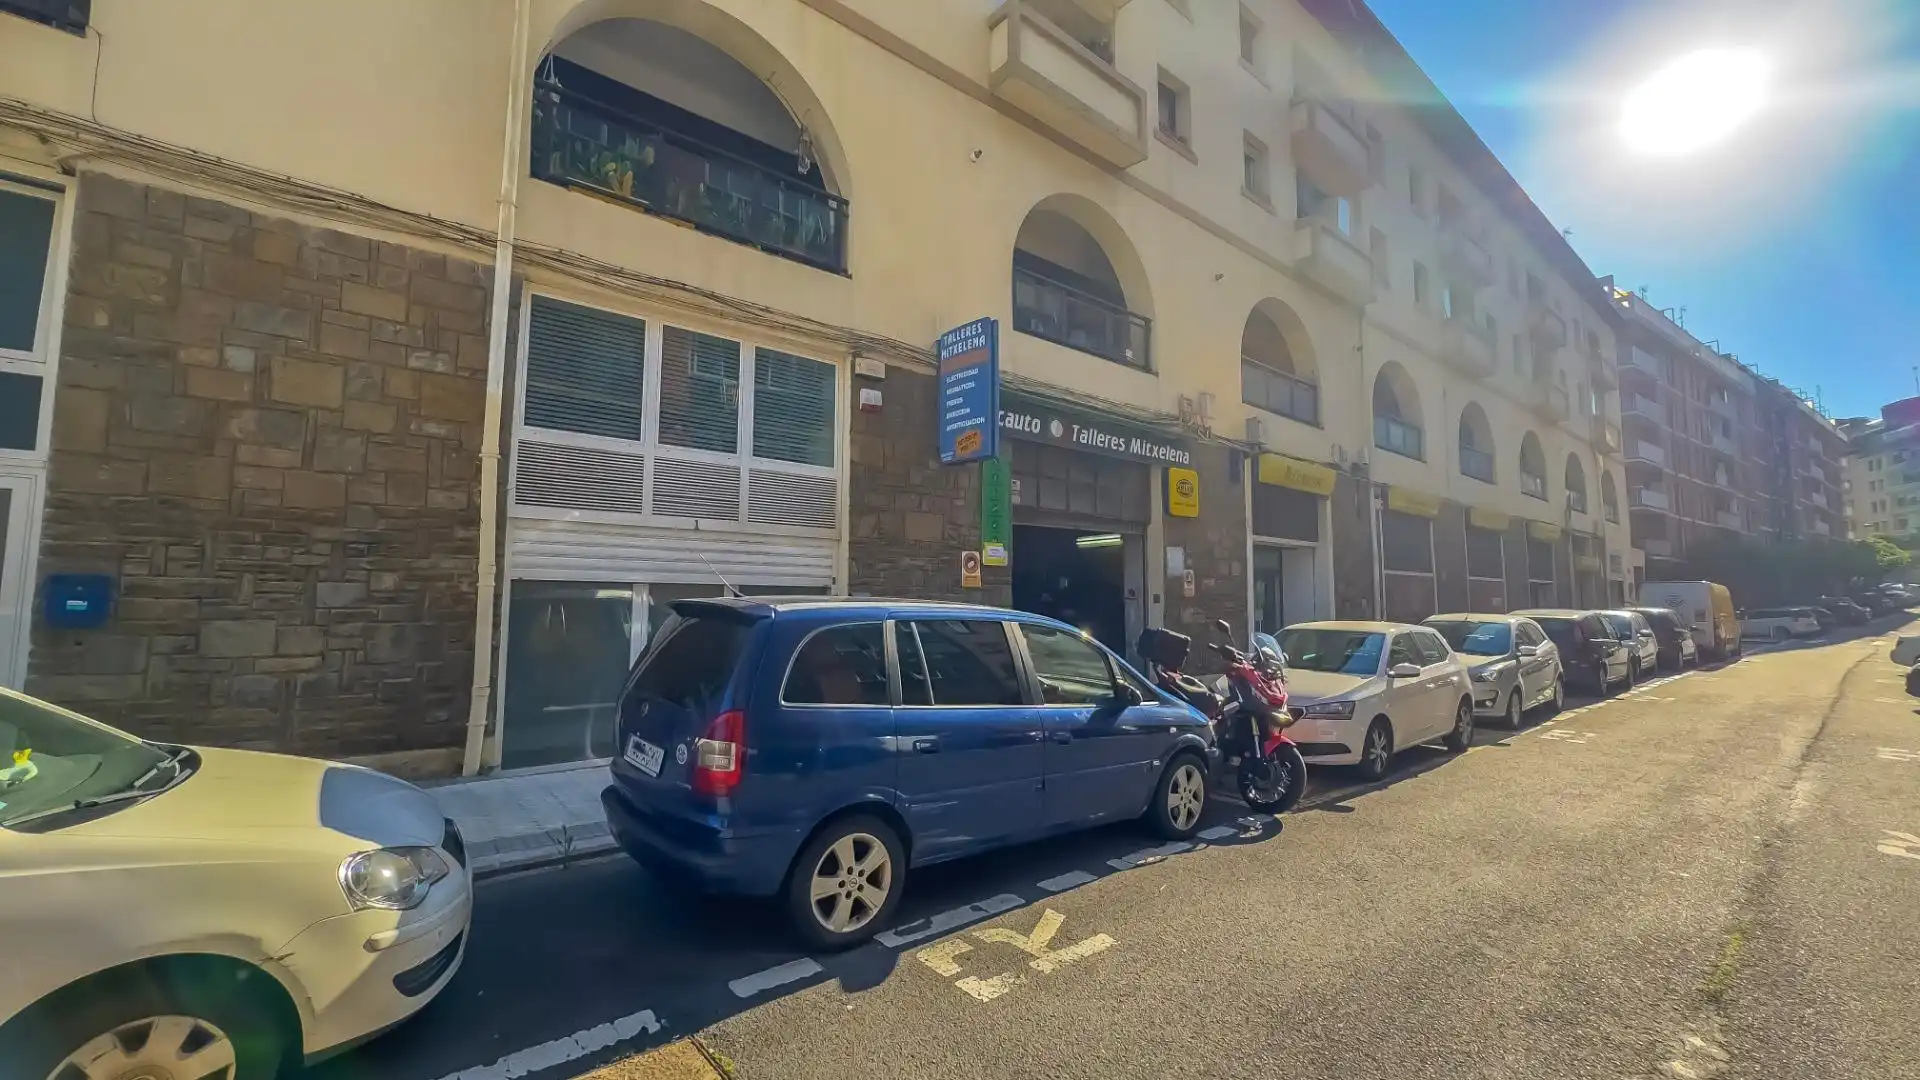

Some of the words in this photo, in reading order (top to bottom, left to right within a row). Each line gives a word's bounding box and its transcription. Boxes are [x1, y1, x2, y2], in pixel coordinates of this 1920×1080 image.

[944, 322, 982, 346] TALLERES
[941, 335, 986, 360] MITXELENA
[1072, 424, 1126, 452] Talleres
[1130, 437, 1190, 464] Mitxelena
